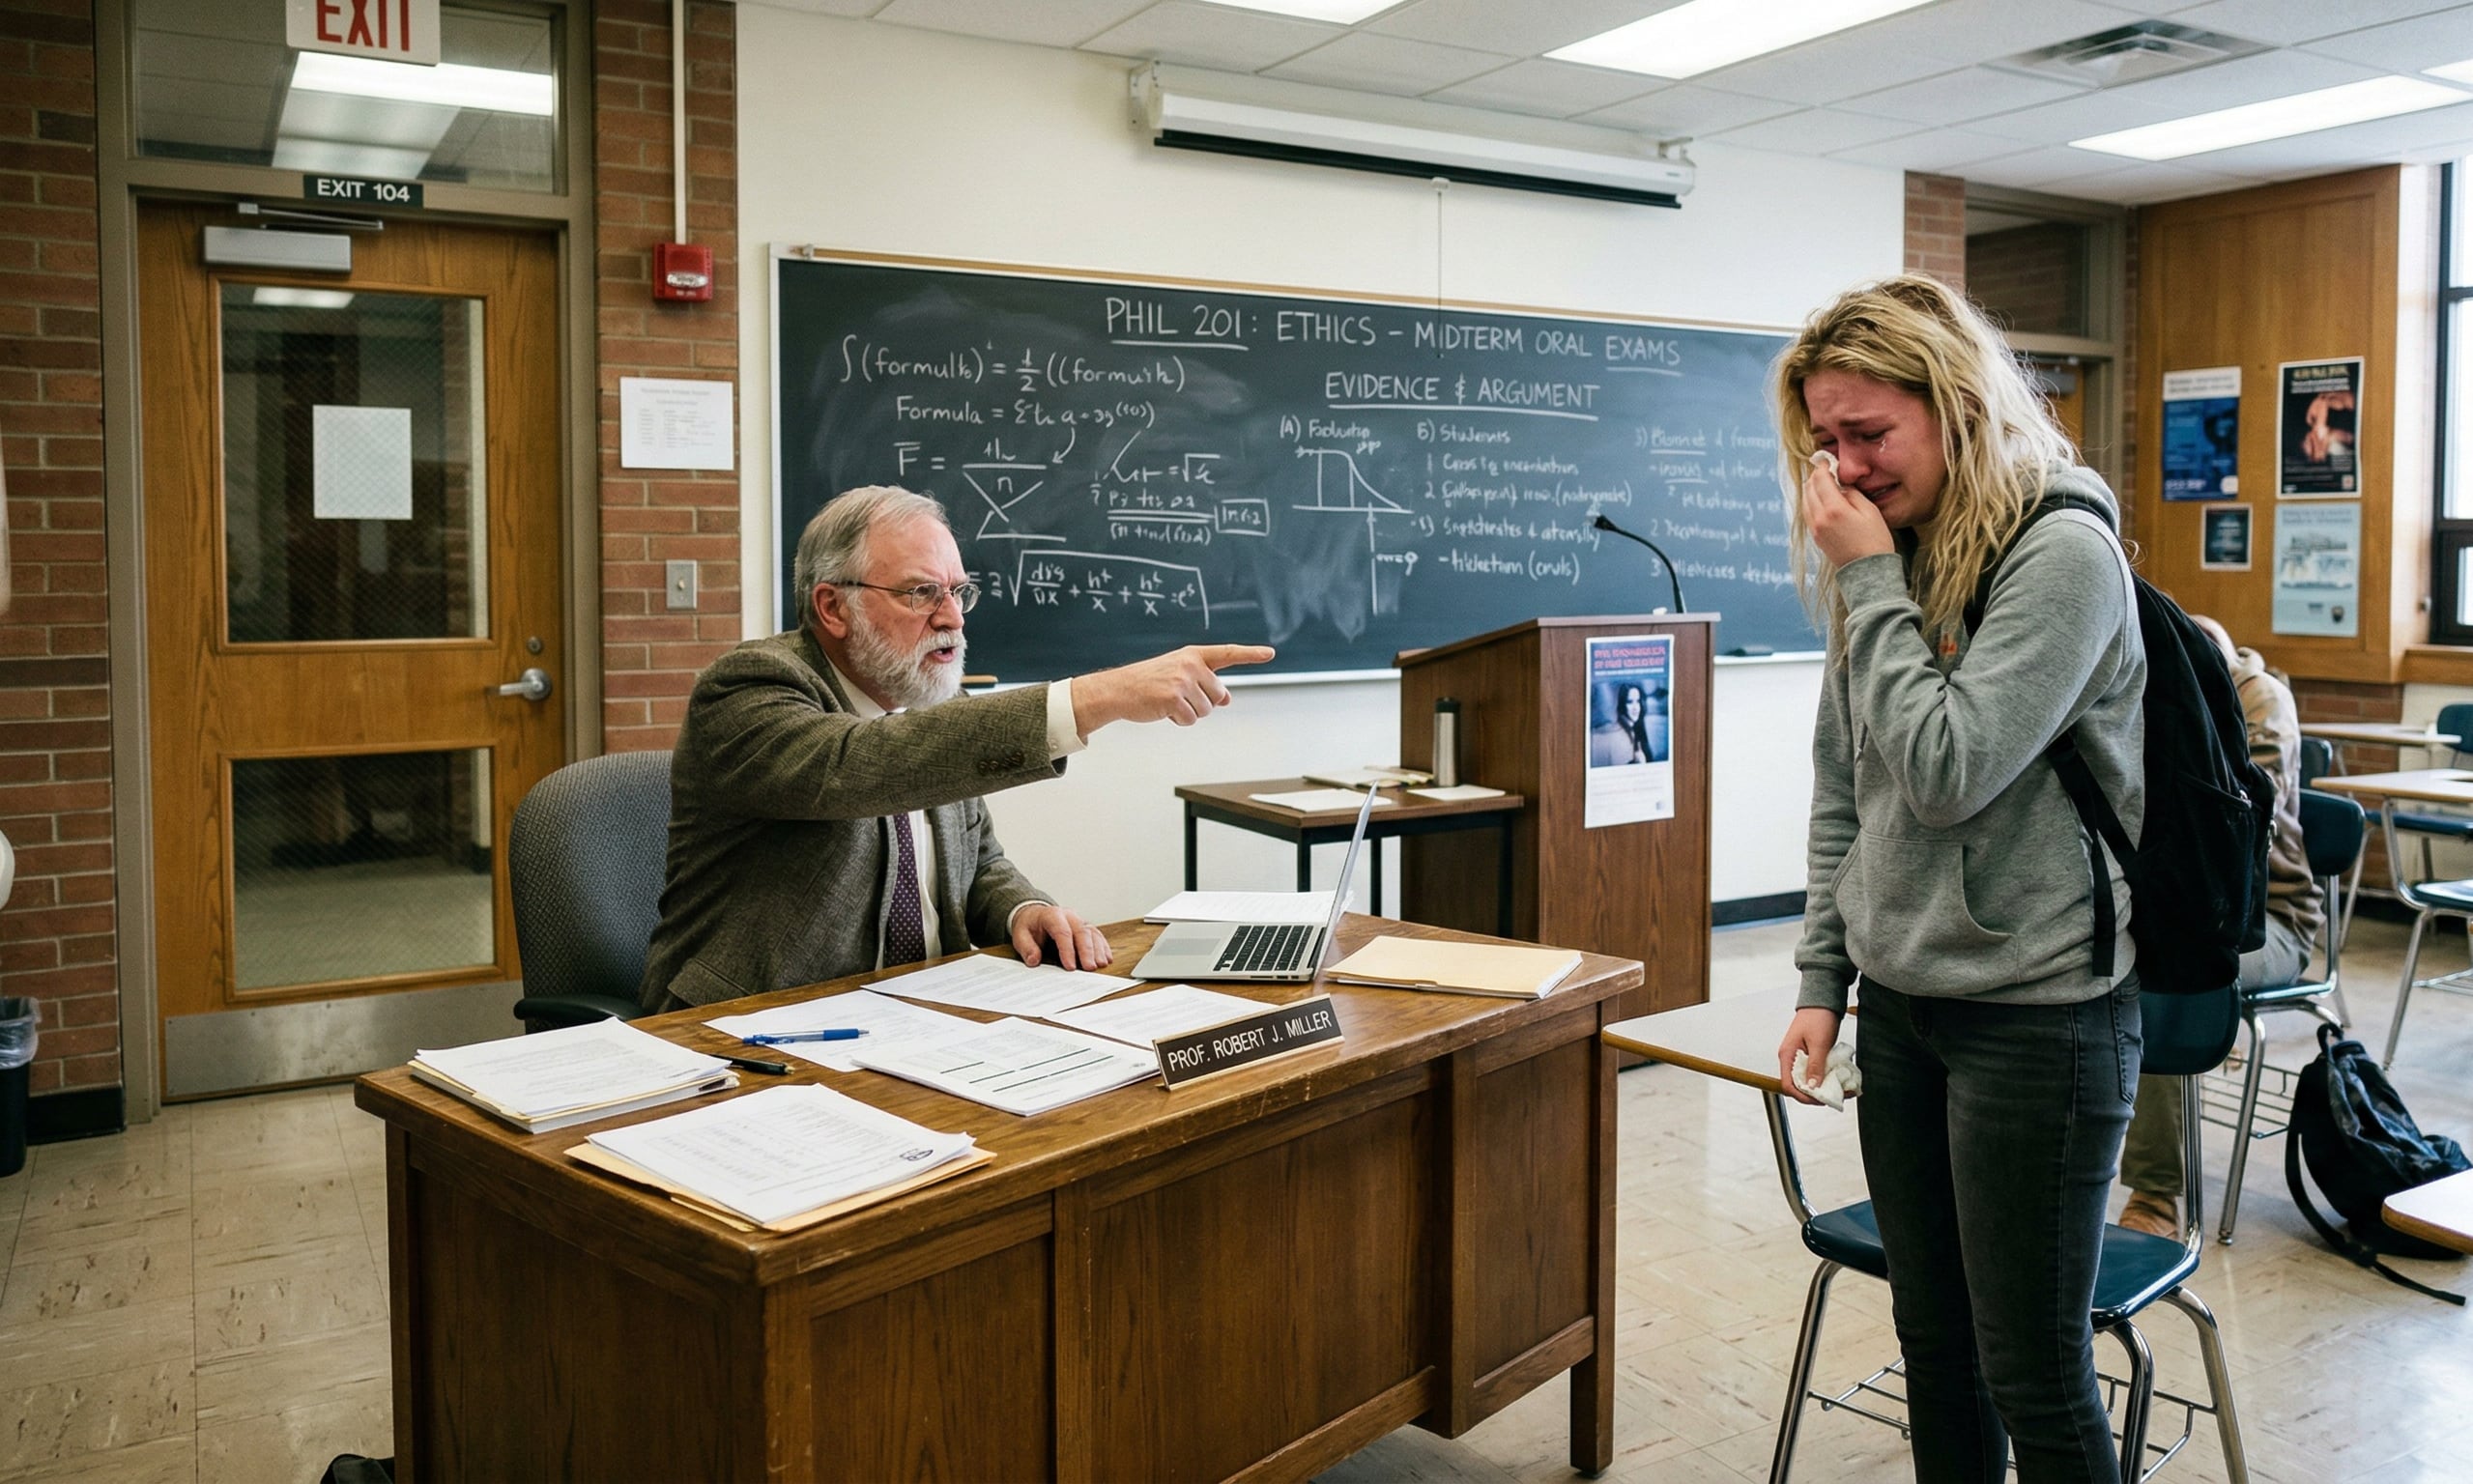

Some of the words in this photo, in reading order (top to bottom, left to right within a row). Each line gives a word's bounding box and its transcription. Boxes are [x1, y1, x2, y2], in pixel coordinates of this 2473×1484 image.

[317, 178, 365, 198] EXIT
[373, 184, 410, 202] 104
[1106, 298, 1179, 334] PHIL
[1193, 304, 1257, 338] 201:
[1278, 311, 1376, 346] ETHICS
[1415, 321, 1524, 354] MIDTERM
[1535, 330, 1593, 357] ORAL
[1605, 335, 1681, 366] EXAMS
[1325, 371, 1440, 400] EVIDENCE
[1454, 372, 1466, 405] &
[1478, 377, 1600, 408] ARGUMENT
[897, 395, 984, 424] Formula
[1167, 1043, 1211, 1071] PROF.
[1213, 1028, 1266, 1059] ROBERT
[1272, 1024, 1283, 1042] J.
[1284, 1010, 1333, 1038] MILLER
